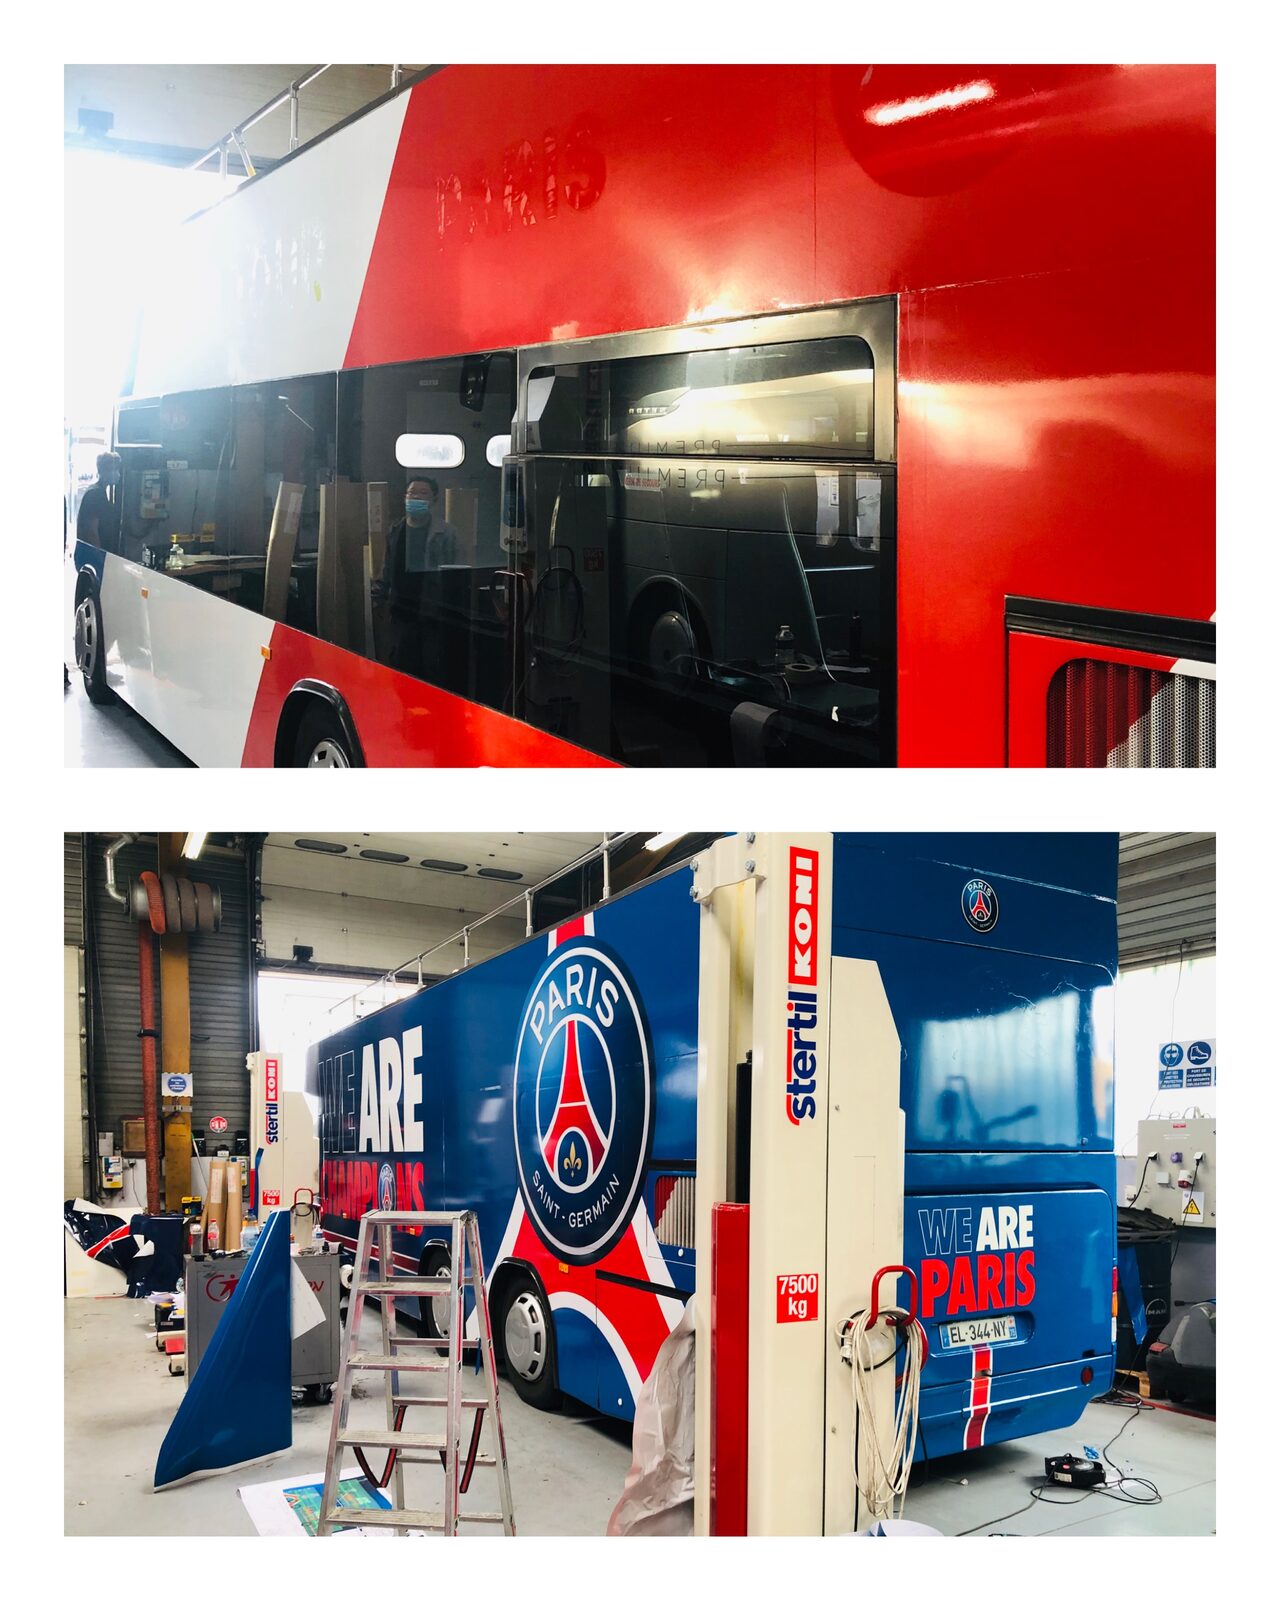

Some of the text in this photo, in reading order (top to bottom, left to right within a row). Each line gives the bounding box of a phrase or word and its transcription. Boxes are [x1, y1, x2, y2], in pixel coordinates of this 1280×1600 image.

[967, 882, 992, 897] PARIS
[794, 855, 813, 978] KONI
[530, 963, 619, 1045] PARIS
[267, 1061, 276, 1100] KONI
[786, 991, 817, 1125] stertil
[318, 1025, 425, 1154] WE ARE
[266, 1103, 278, 1145] stertil
[267, 1197, 276, 1205] kg
[532, 1170, 620, 1228] SAINT GERMAIN
[918, 1205, 1034, 1256] WE ARE
[779, 1275, 817, 1295] 7500
[788, 1297, 808, 1319] kg
[921, 1250, 1036, 1318] PARIS
